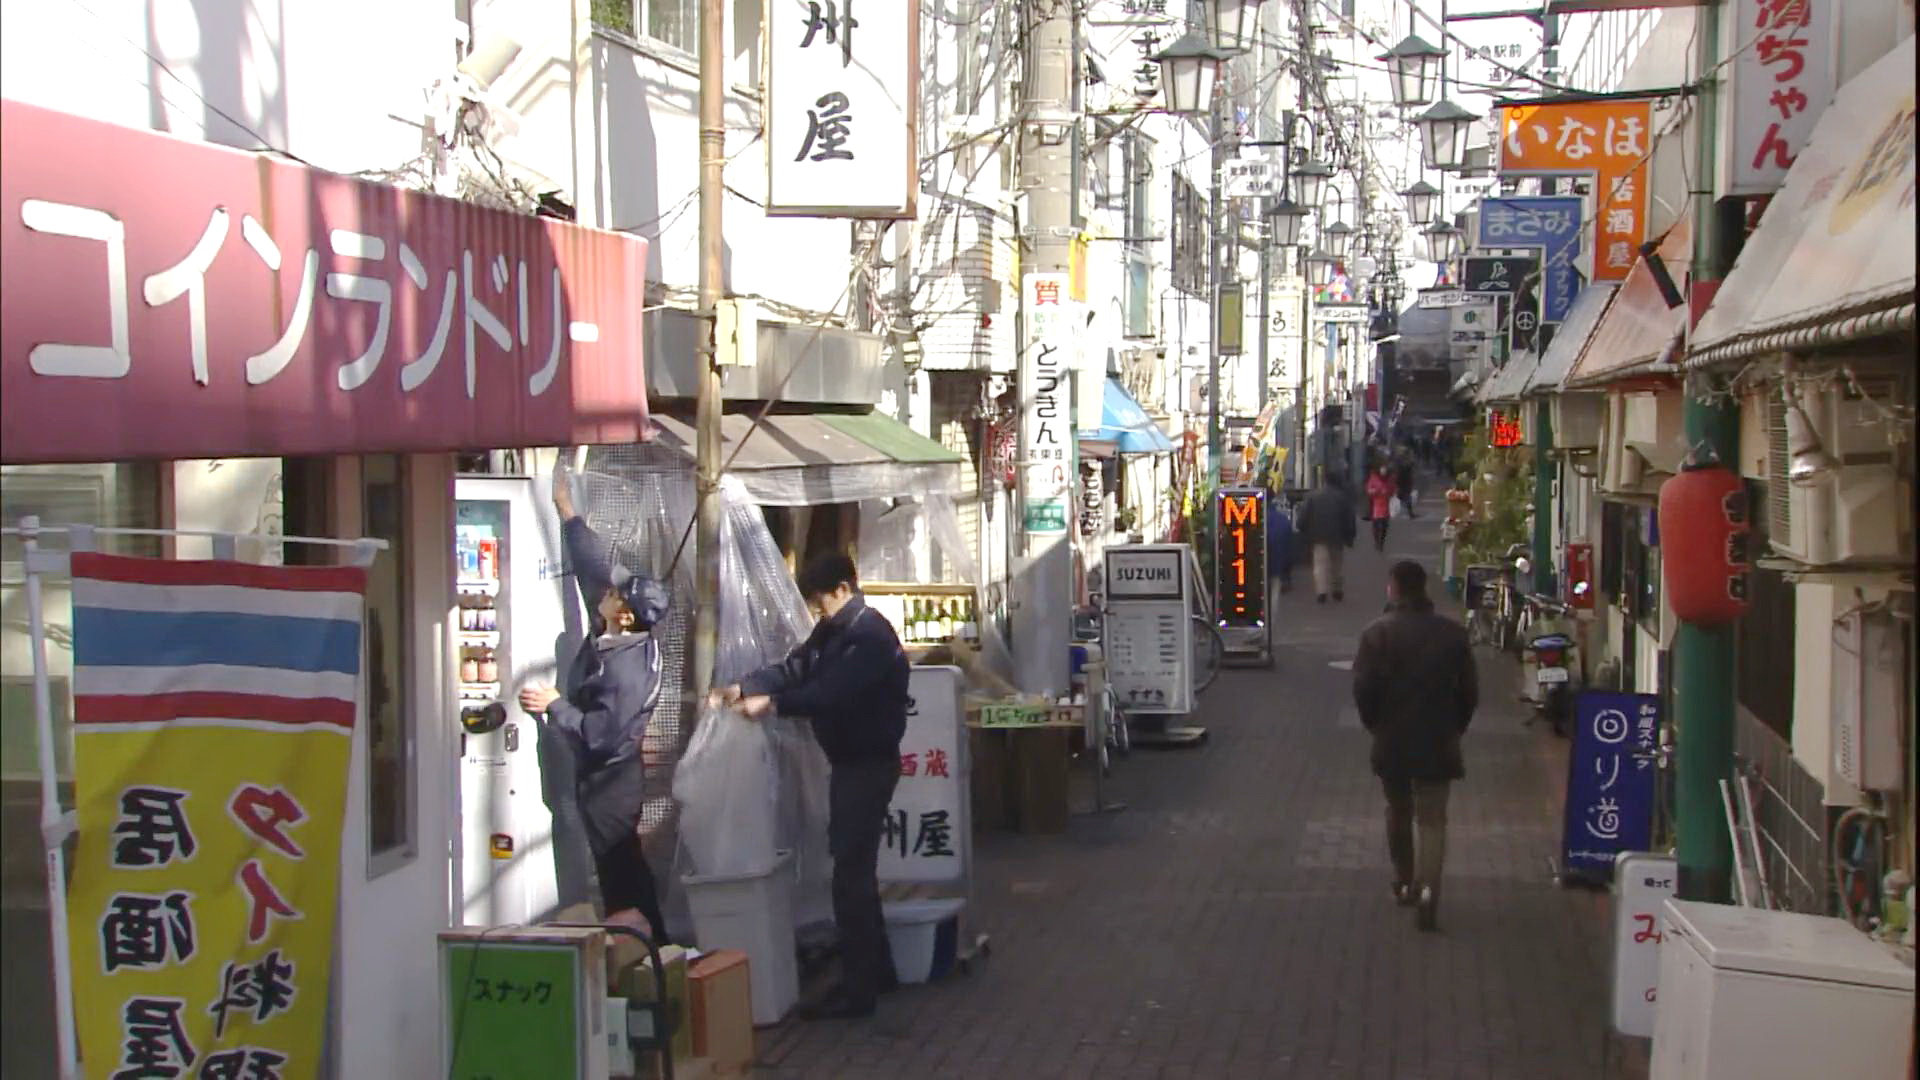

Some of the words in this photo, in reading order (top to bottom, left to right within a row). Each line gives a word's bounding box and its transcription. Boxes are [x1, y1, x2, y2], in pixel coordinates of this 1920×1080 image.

[794, 0, 859, 162] 州屋
[1508, 116, 1644, 159] いなほ
[1487, 208, 1572, 237] まさみ
[1605, 176, 1635, 268] 居酒屋
[21, 199, 600, 398] コインランドリー
[1034, 280, 1060, 306] 質
[473, 977, 553, 1004] スナック
